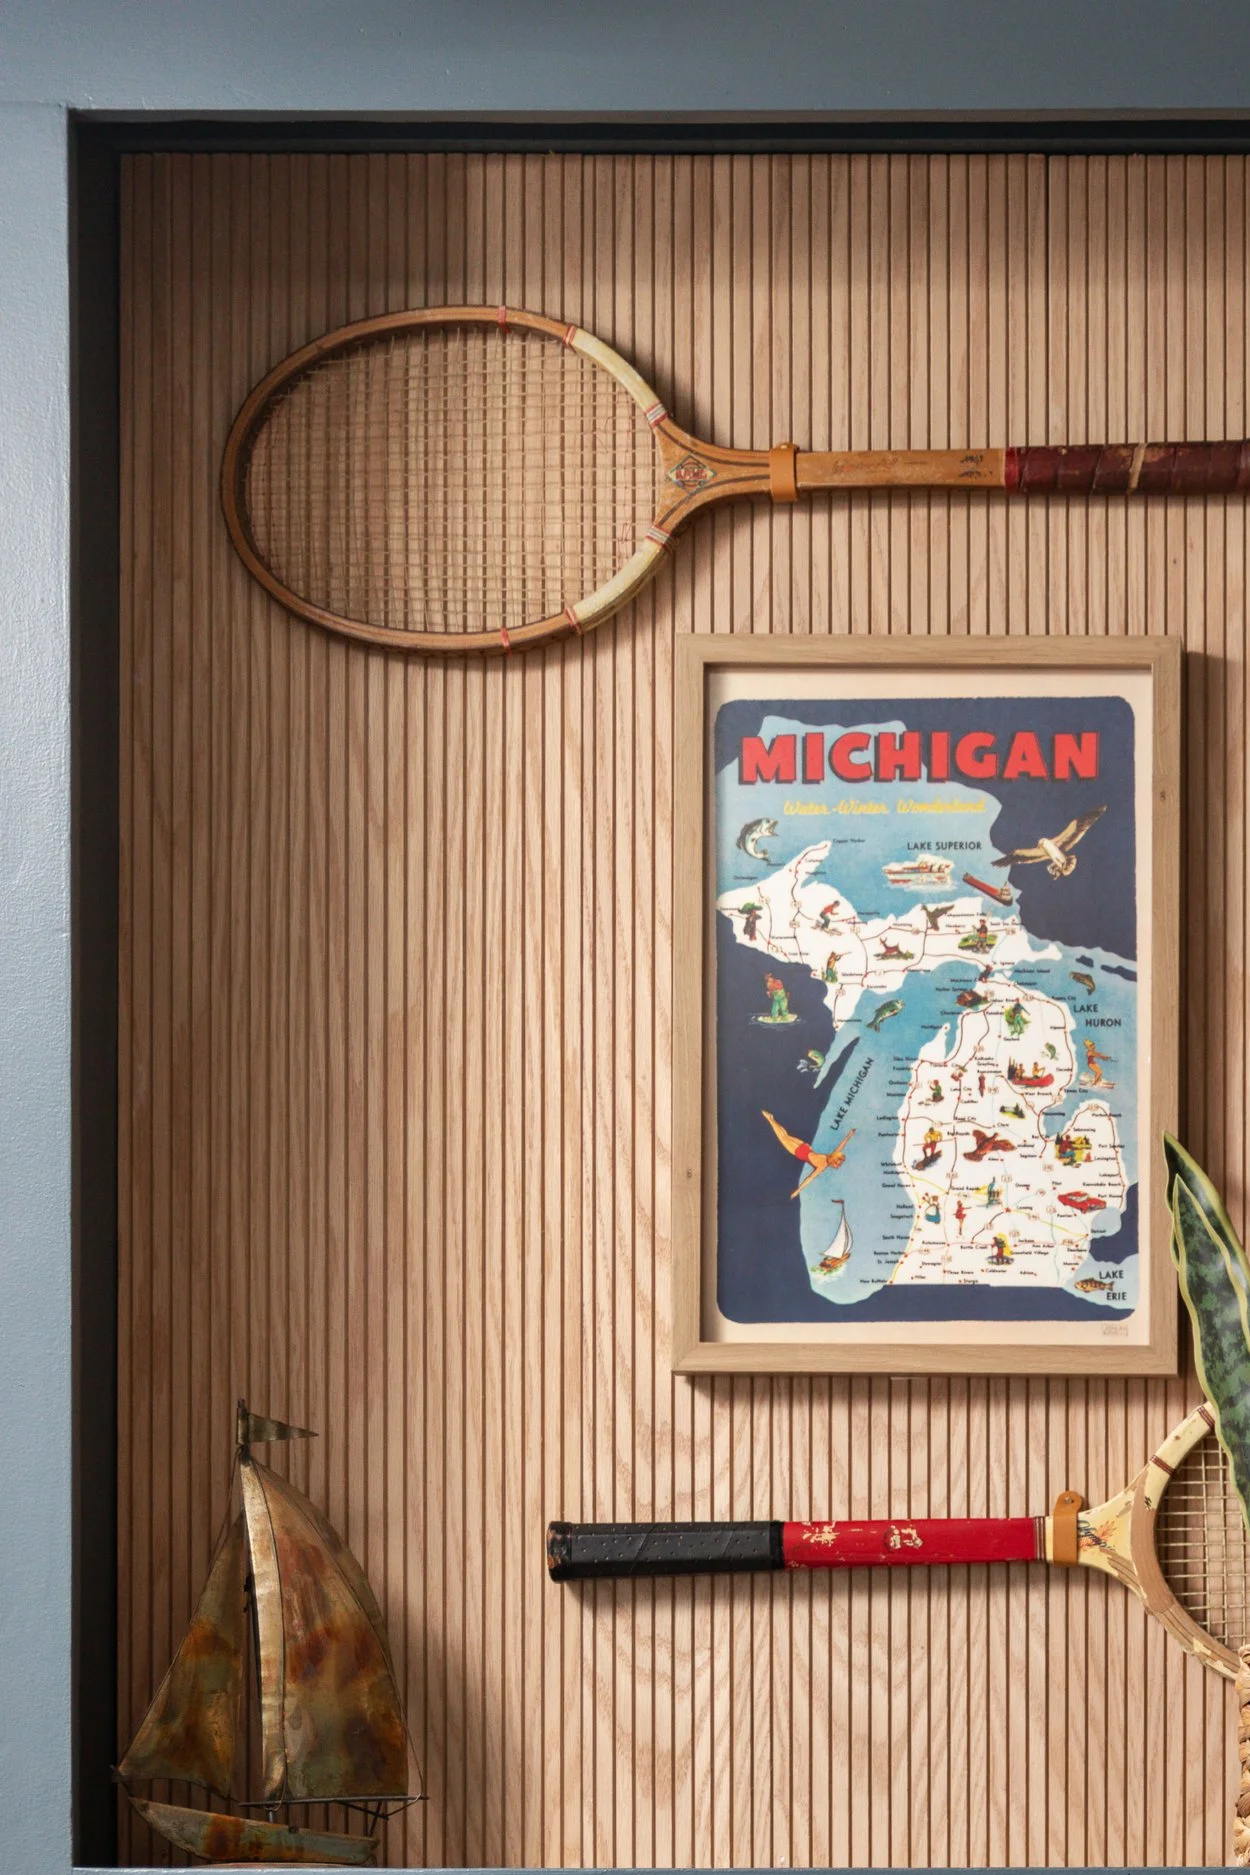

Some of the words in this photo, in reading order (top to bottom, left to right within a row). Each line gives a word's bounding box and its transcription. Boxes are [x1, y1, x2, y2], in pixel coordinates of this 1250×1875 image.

[739, 731, 1100, 785] MICHIGAN
[907, 841, 932, 850] LAKE
[936, 841, 982, 850] SUPERIOR
[1073, 1004, 1098, 1013] LAKE
[1085, 1018, 1122, 1027] HURON
[830, 1106, 848, 1131] LAKE
[844, 1057, 875, 1107] MICHIGAN
[1099, 1270, 1125, 1280] LAKE
[1106, 1291, 1127, 1301] ERIE
